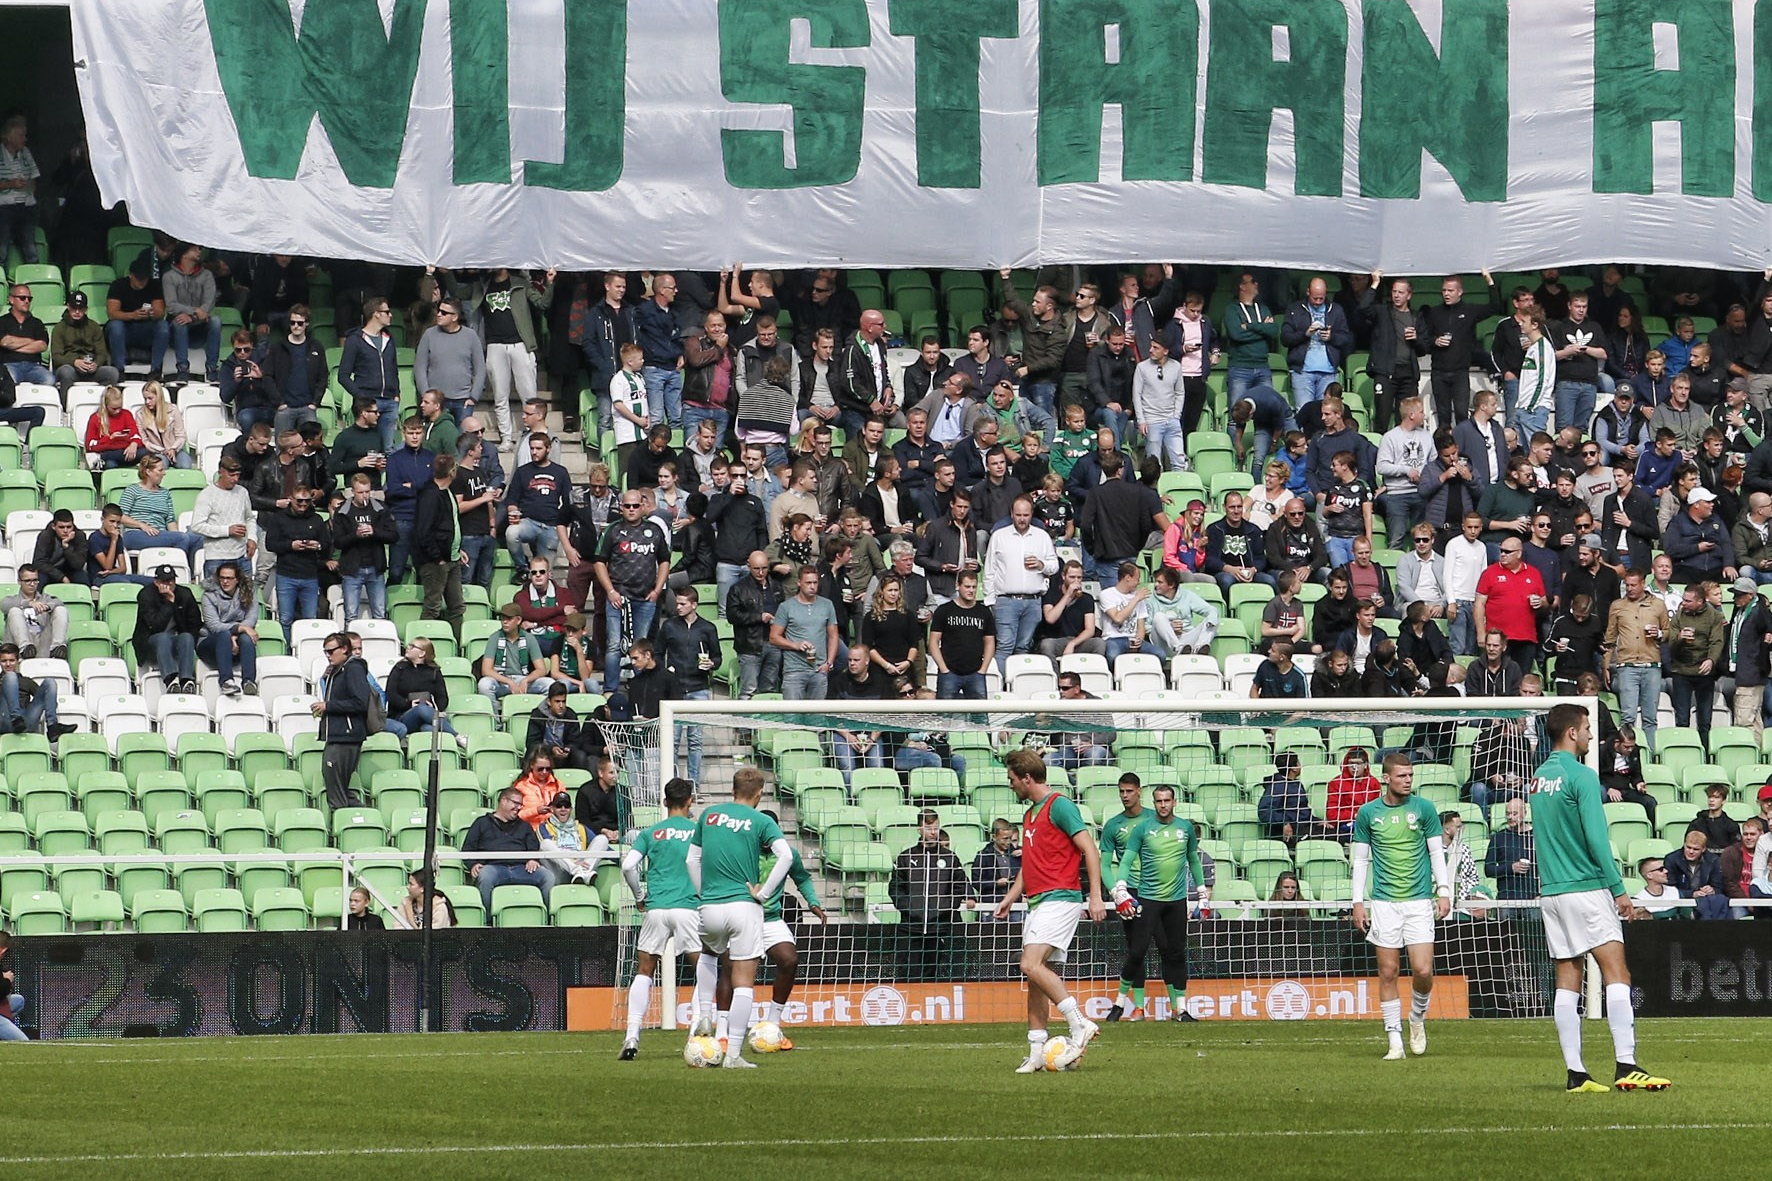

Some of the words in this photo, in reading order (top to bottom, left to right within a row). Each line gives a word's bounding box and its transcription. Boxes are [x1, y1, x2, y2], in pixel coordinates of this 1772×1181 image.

[1336, 496, 1360, 508] Payt
[630, 542, 655, 555] Payt
[1537, 776, 1562, 796] Payt
[718, 813, 752, 832] Payt
[1391, 815, 1400, 824] 21
